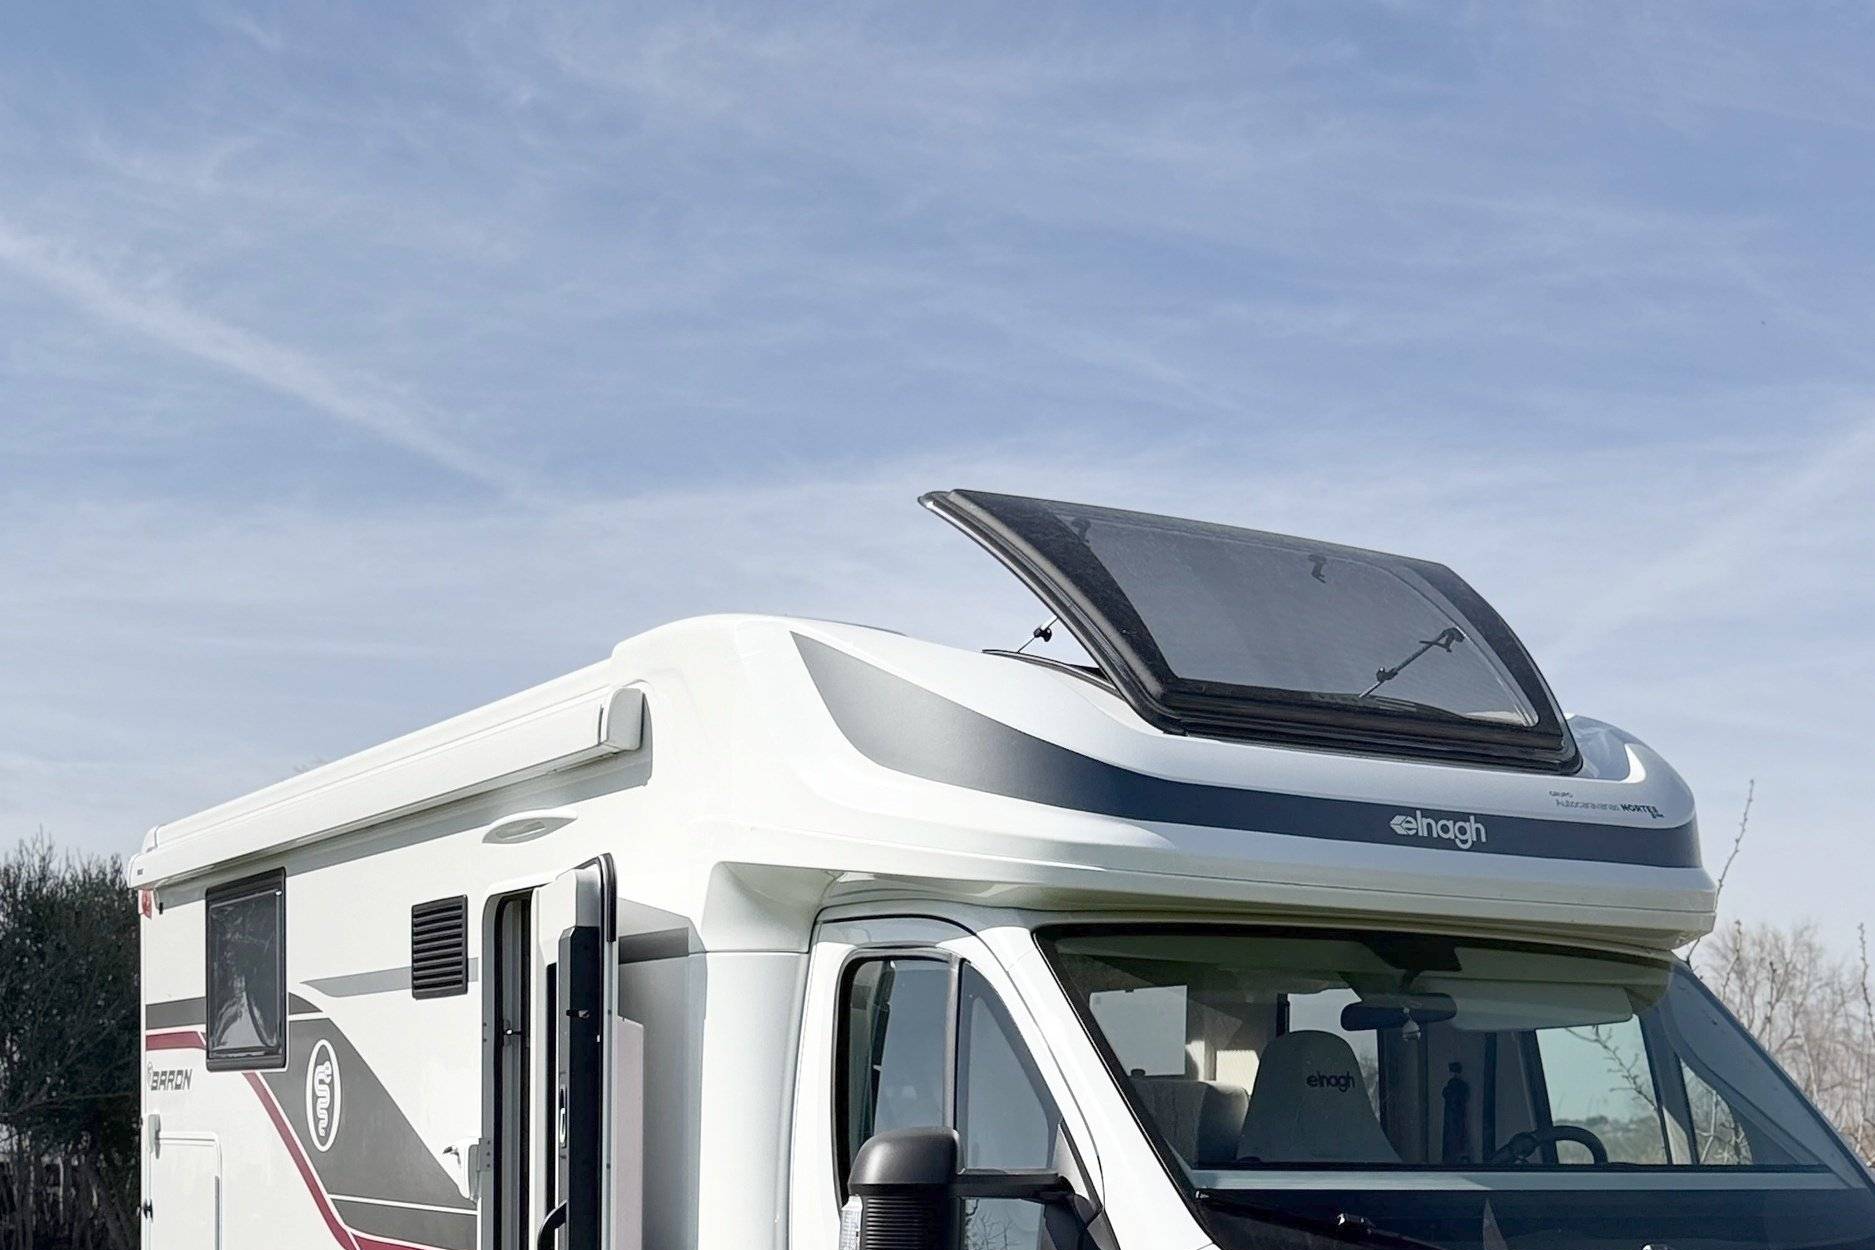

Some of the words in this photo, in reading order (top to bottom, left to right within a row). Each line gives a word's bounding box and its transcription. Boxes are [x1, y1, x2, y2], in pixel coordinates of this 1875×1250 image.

[1400, 810, 1486, 849] elnagh
[151, 1069, 192, 1091] BARON
[1306, 1071, 1355, 1092] elnagh
